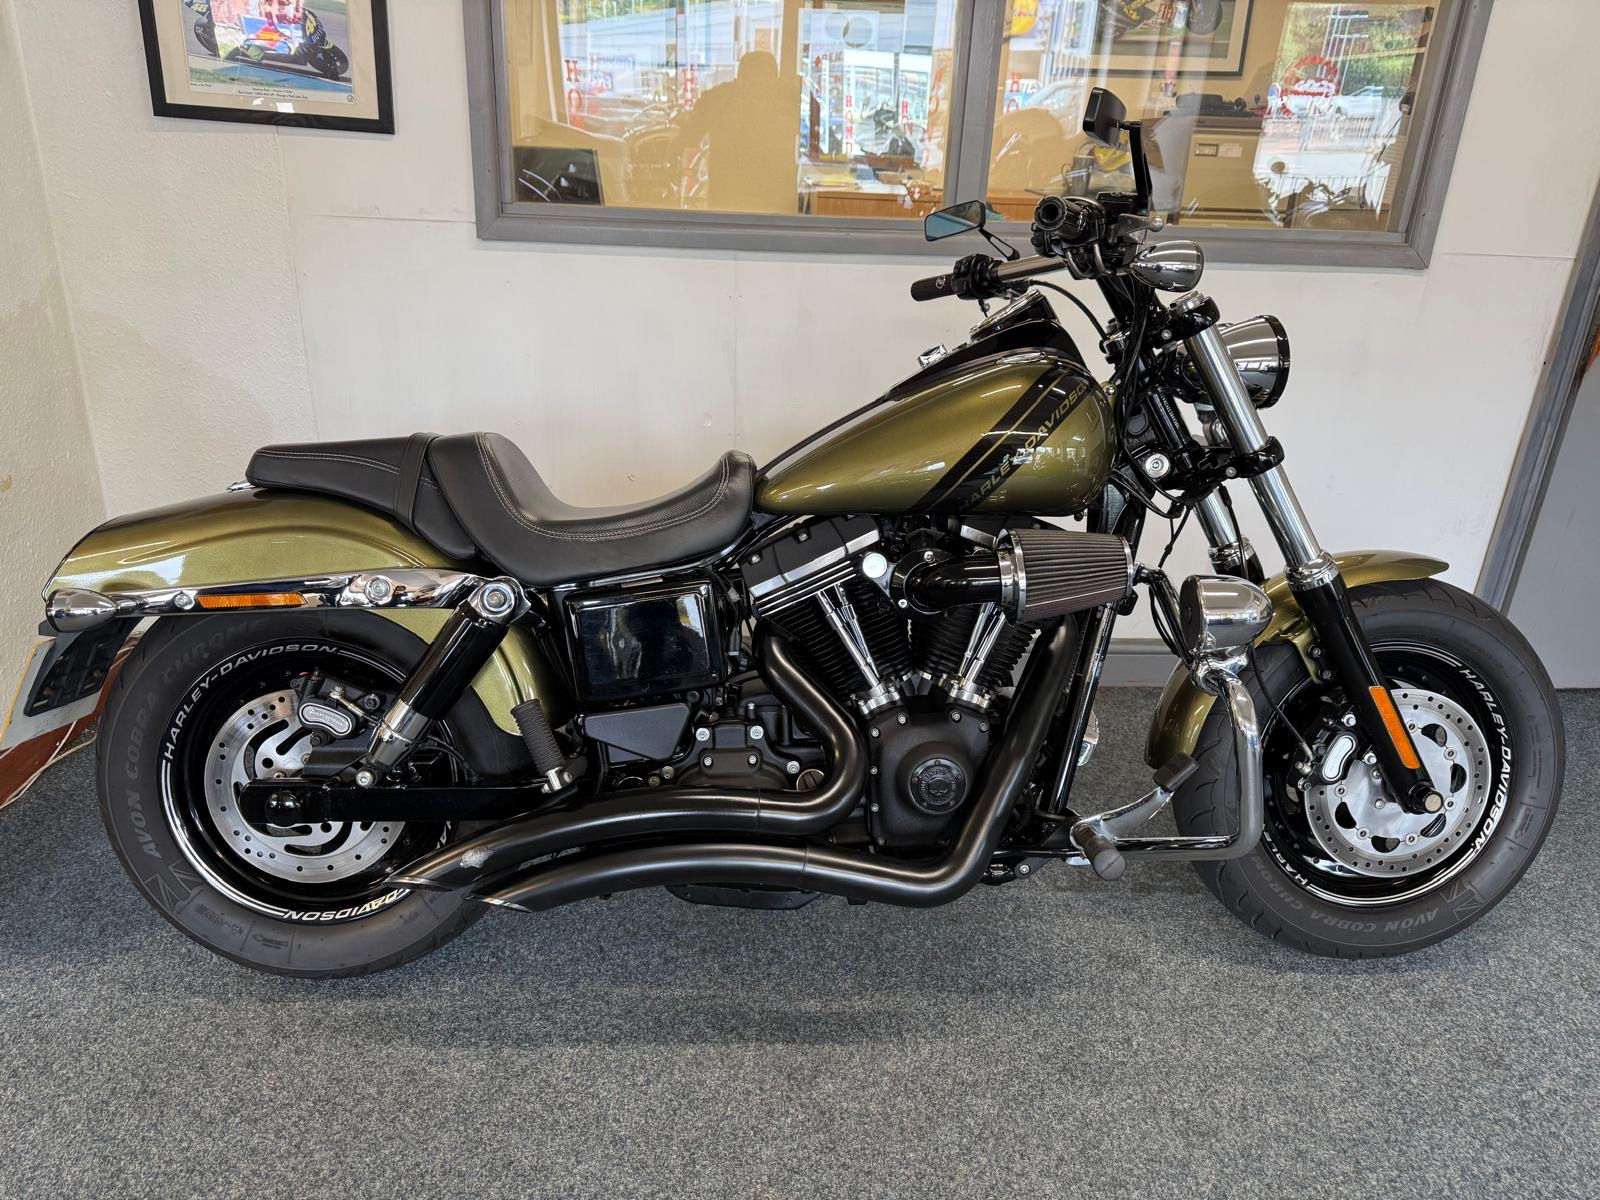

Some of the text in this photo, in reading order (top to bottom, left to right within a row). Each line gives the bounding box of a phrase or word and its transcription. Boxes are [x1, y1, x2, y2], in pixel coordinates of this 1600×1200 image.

[125, 691, 160, 780] COBRA
[164, 643, 337, 761] HARLEY-DAVIDSON
[1459, 668, 1512, 851] HARLEY-DAVIDSON
[127, 791, 162, 859] AVON
[1262, 831, 1309, 888] HARLE
[1251, 855, 1439, 933] AVON COBRA CHROM
